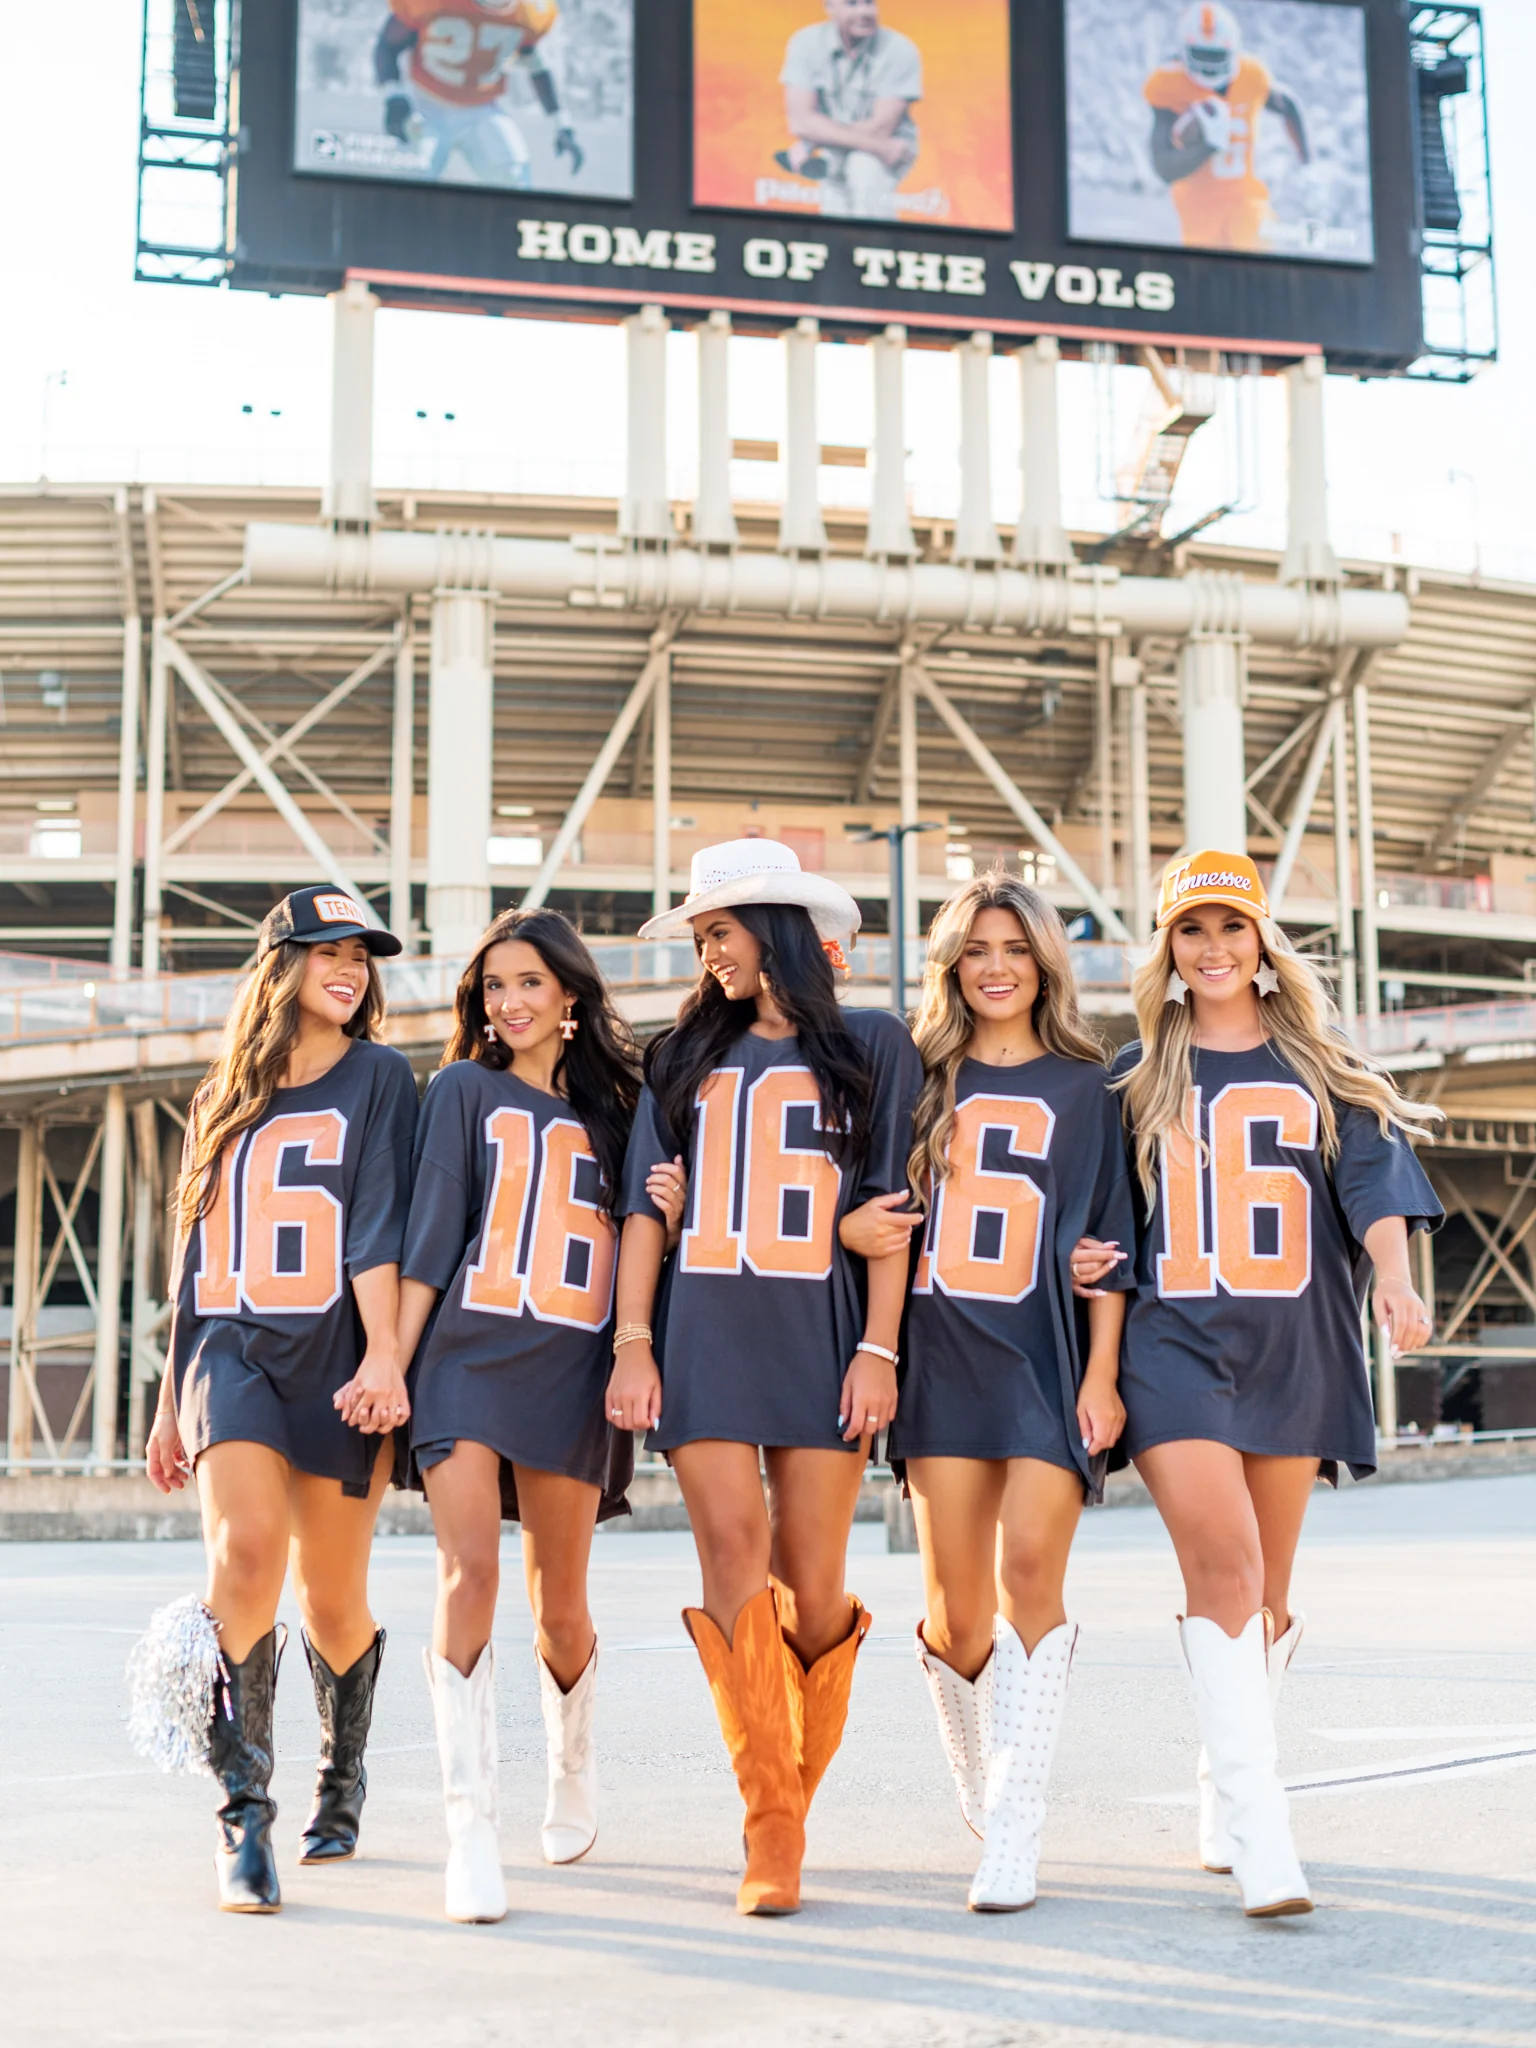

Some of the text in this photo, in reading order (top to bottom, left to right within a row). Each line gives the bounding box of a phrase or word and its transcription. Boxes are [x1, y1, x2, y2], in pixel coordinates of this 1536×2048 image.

[422, 16, 524, 87] 27
[517, 219, 1175, 311] HOME OF THE VOLS
[1168, 862, 1252, 902] Tennessee
[560, 1020, 578, 1039] T
[194, 1108, 348, 1315] 16
[461, 1106, 619, 1333] 16
[680, 1065, 851, 1280] 16
[912, 1093, 1056, 1304] 6
[1156, 1081, 1318, 1298] 16
